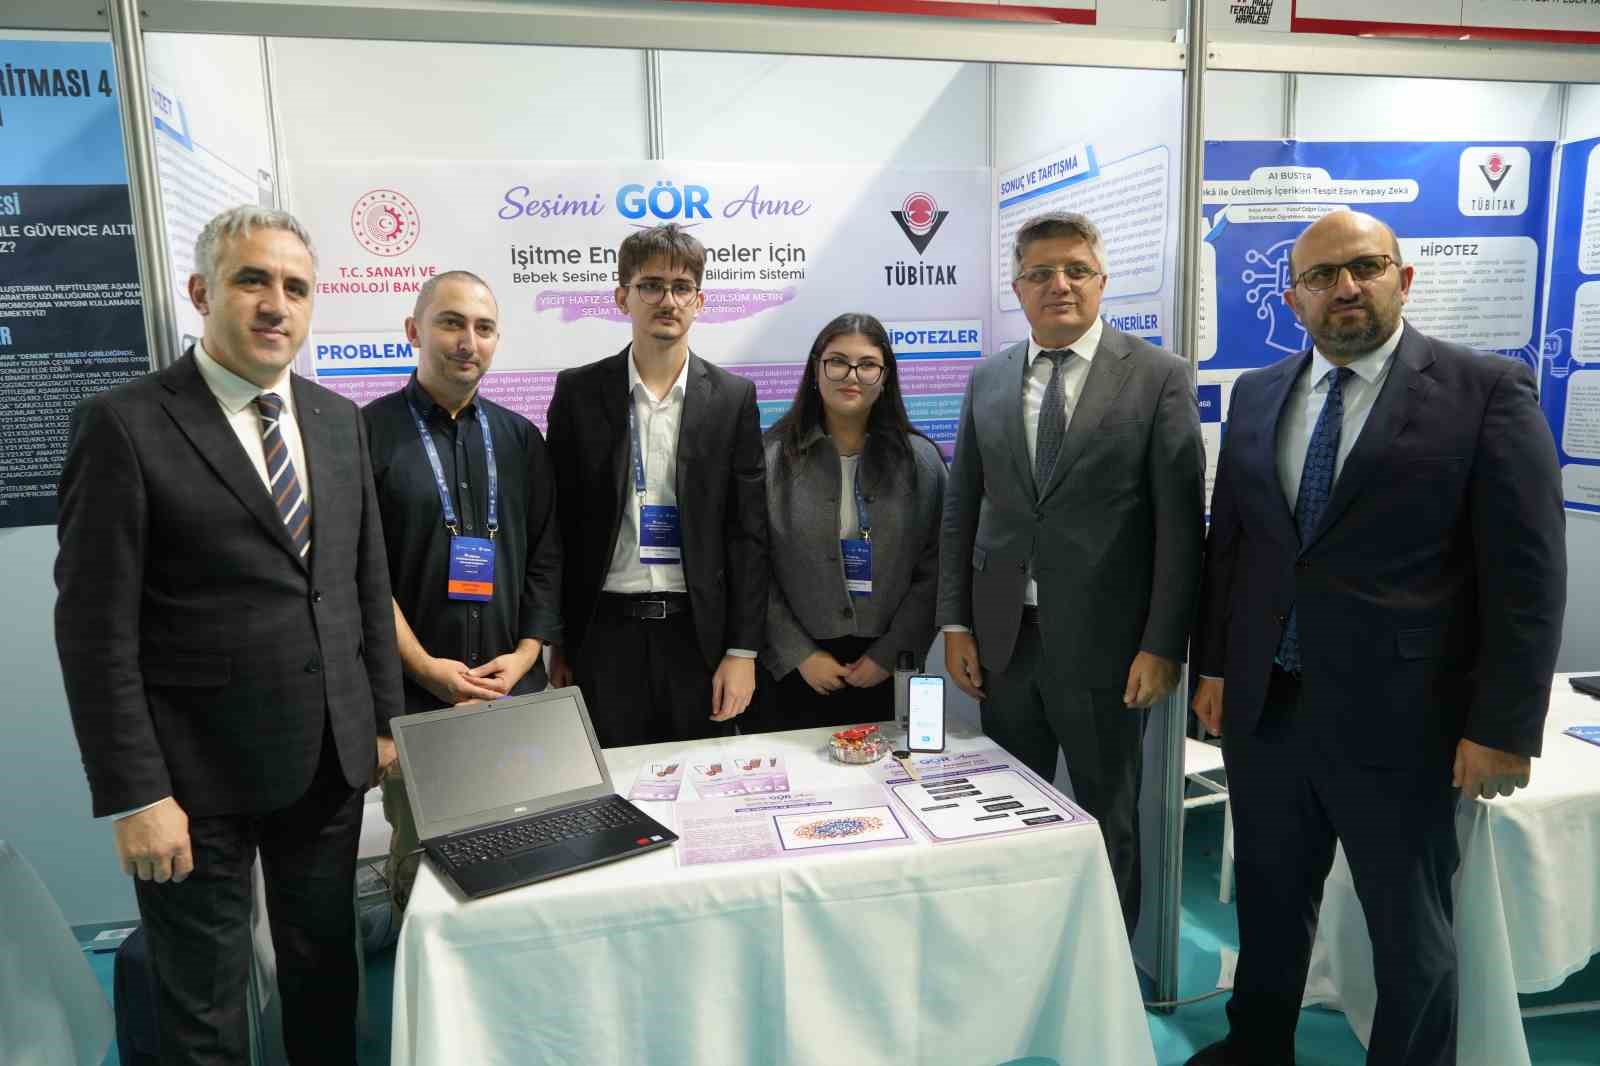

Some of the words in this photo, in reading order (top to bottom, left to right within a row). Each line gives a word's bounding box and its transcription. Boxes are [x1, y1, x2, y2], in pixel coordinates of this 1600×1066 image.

[97, 69, 112, 97] 4
[1000, 175, 1025, 195] SONUÇ
[1026, 171, 1037, 185] VE
[1038, 155, 1078, 179] TARTIŞMA
[1281, 172, 1312, 180] BUSTER
[498, 185, 606, 220] Sesimi
[615, 181, 713, 220] GÖR
[722, 185, 814, 218] Anne
[1472, 197, 1517, 211] TÜBİTAK
[0, 225, 21, 237] LE
[24, 223, 98, 237] GÜVENCE
[511, 244, 582, 270] İşitme
[769, 242, 806, 267] İçin
[1420, 242, 1479, 256] HİPOTEZ
[340, 266, 362, 278] T.C.
[366, 264, 416, 278] SANAYİ
[419, 266, 437, 277] VE
[513, 271, 558, 284] Bebek
[562, 270, 608, 282] Sesine
[705, 268, 756, 280] Bildirim
[759, 268, 805, 280] Sistemi
[885, 261, 957, 286] TÜBİTAK
[889, 328, 978, 345] İPOTEZLER
[316, 342, 413, 360] PROBLEM
